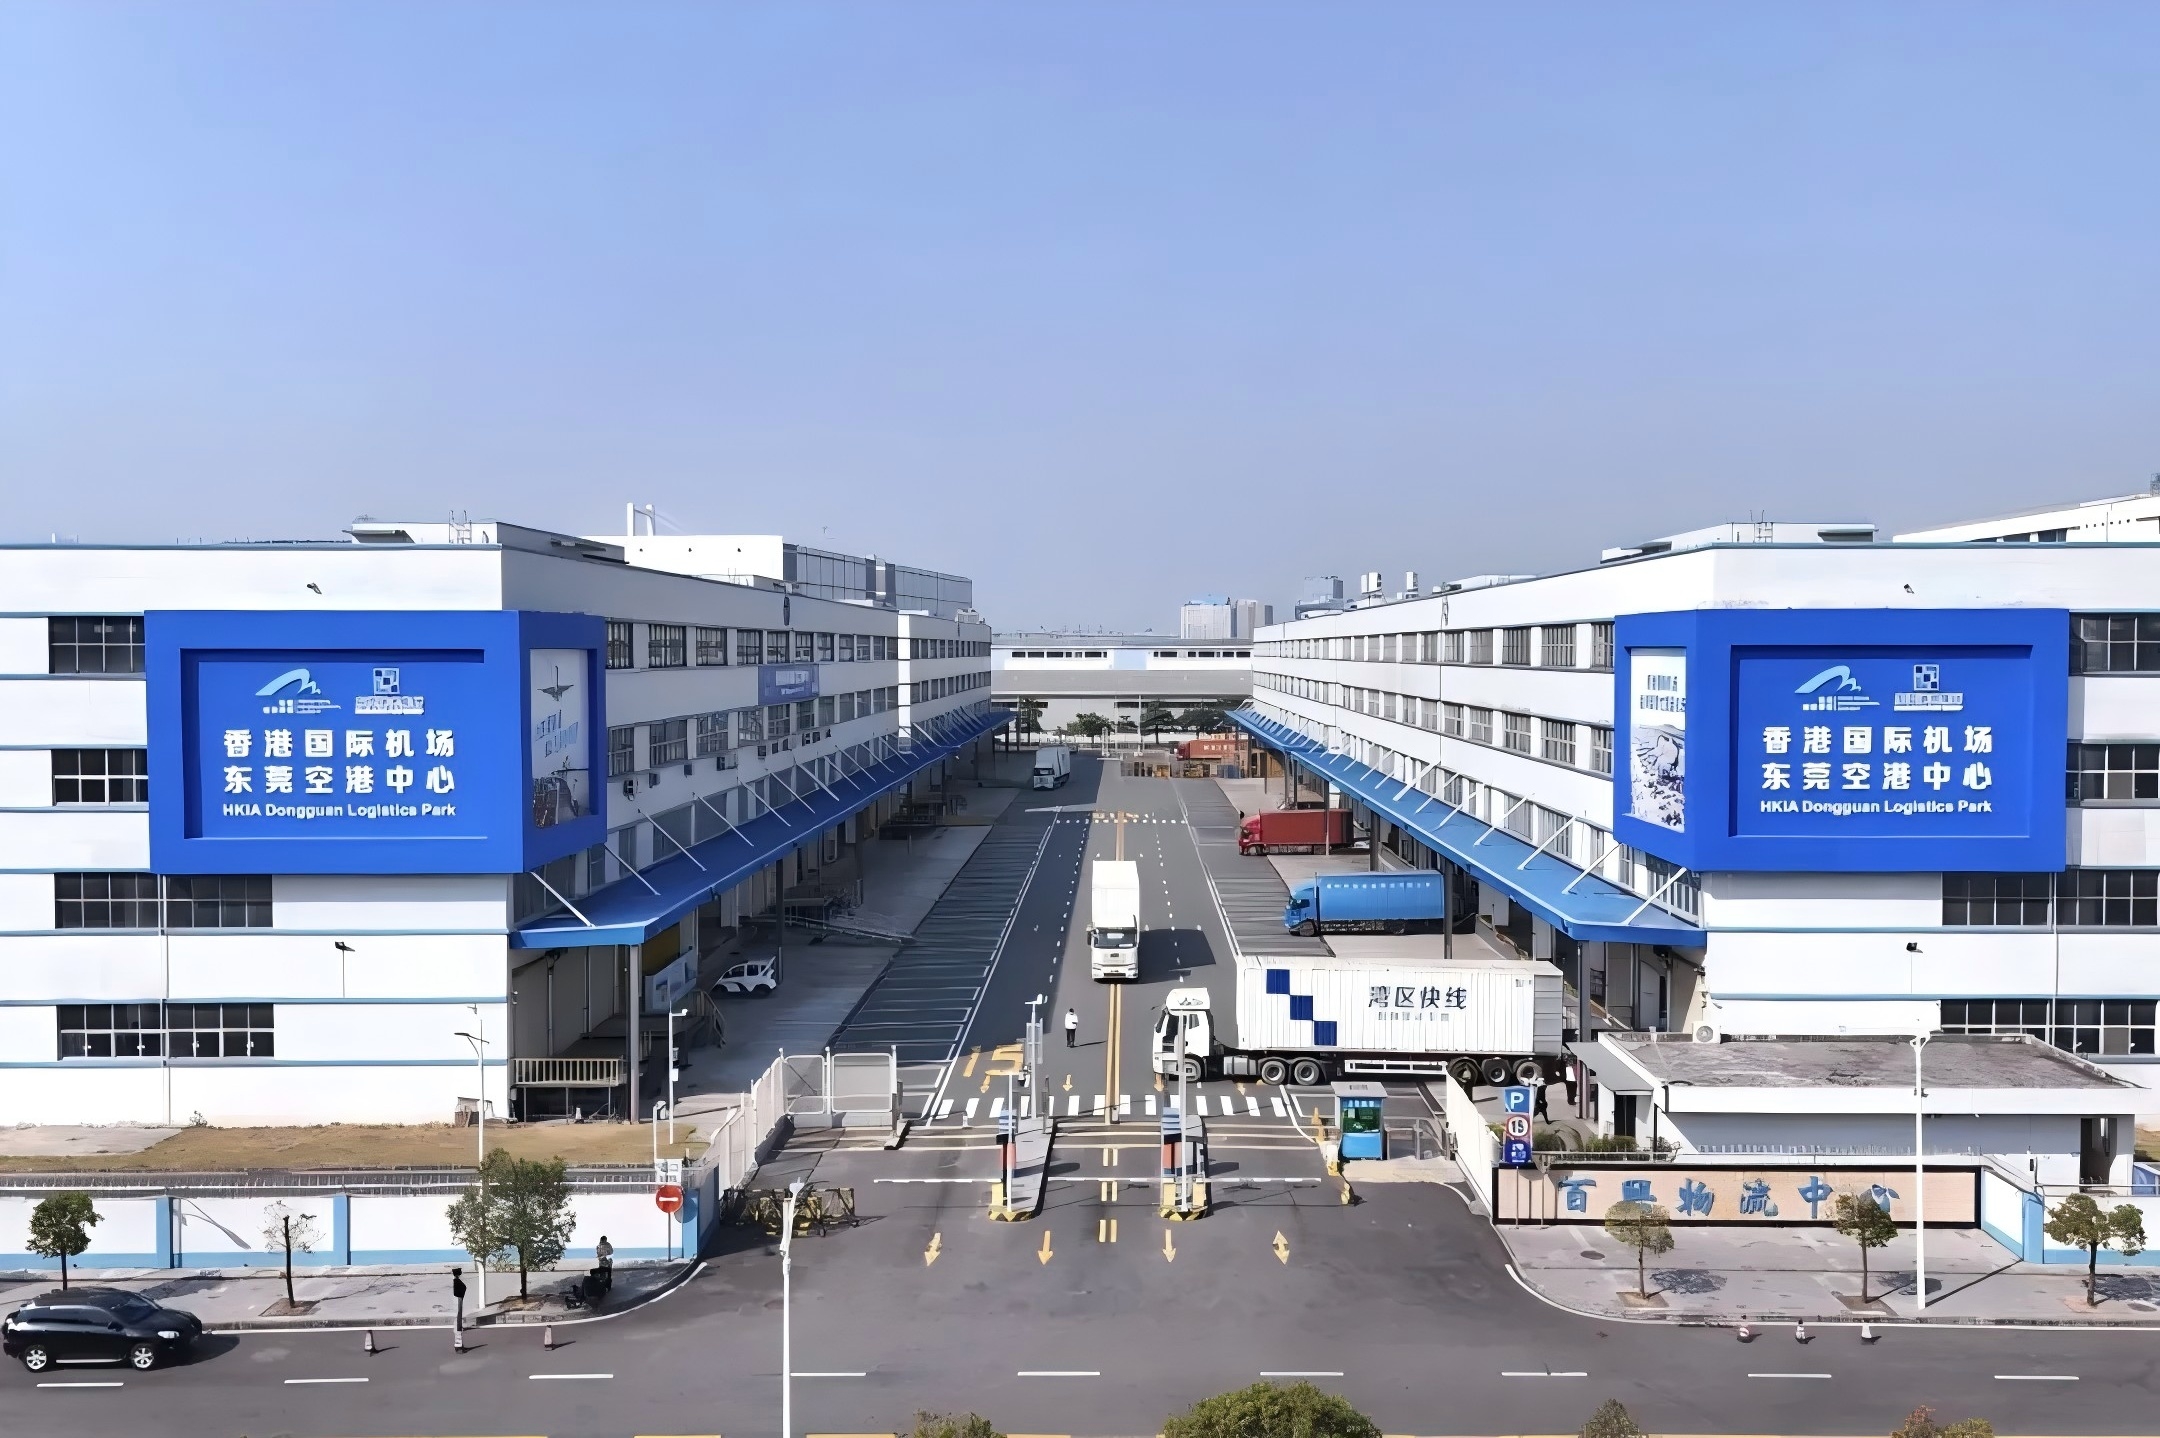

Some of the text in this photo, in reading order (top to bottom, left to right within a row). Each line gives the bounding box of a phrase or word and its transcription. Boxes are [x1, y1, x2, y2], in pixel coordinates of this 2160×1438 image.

[224, 729, 453, 757] 香港国际机场
[1763, 726, 1992, 753] 香港国际机场
[224, 765, 454, 793] 东莞空港中心
[1762, 762, 1991, 790] 东莞空港中心
[223, 804, 455, 819] HKIA Dongguan Logistics Park
[1761, 800, 1991, 815] HKIA Dongguan Logistics Park
[1368, 986, 1468, 1010] 湾区快线
[1511, 1092, 1525, 1109] P
